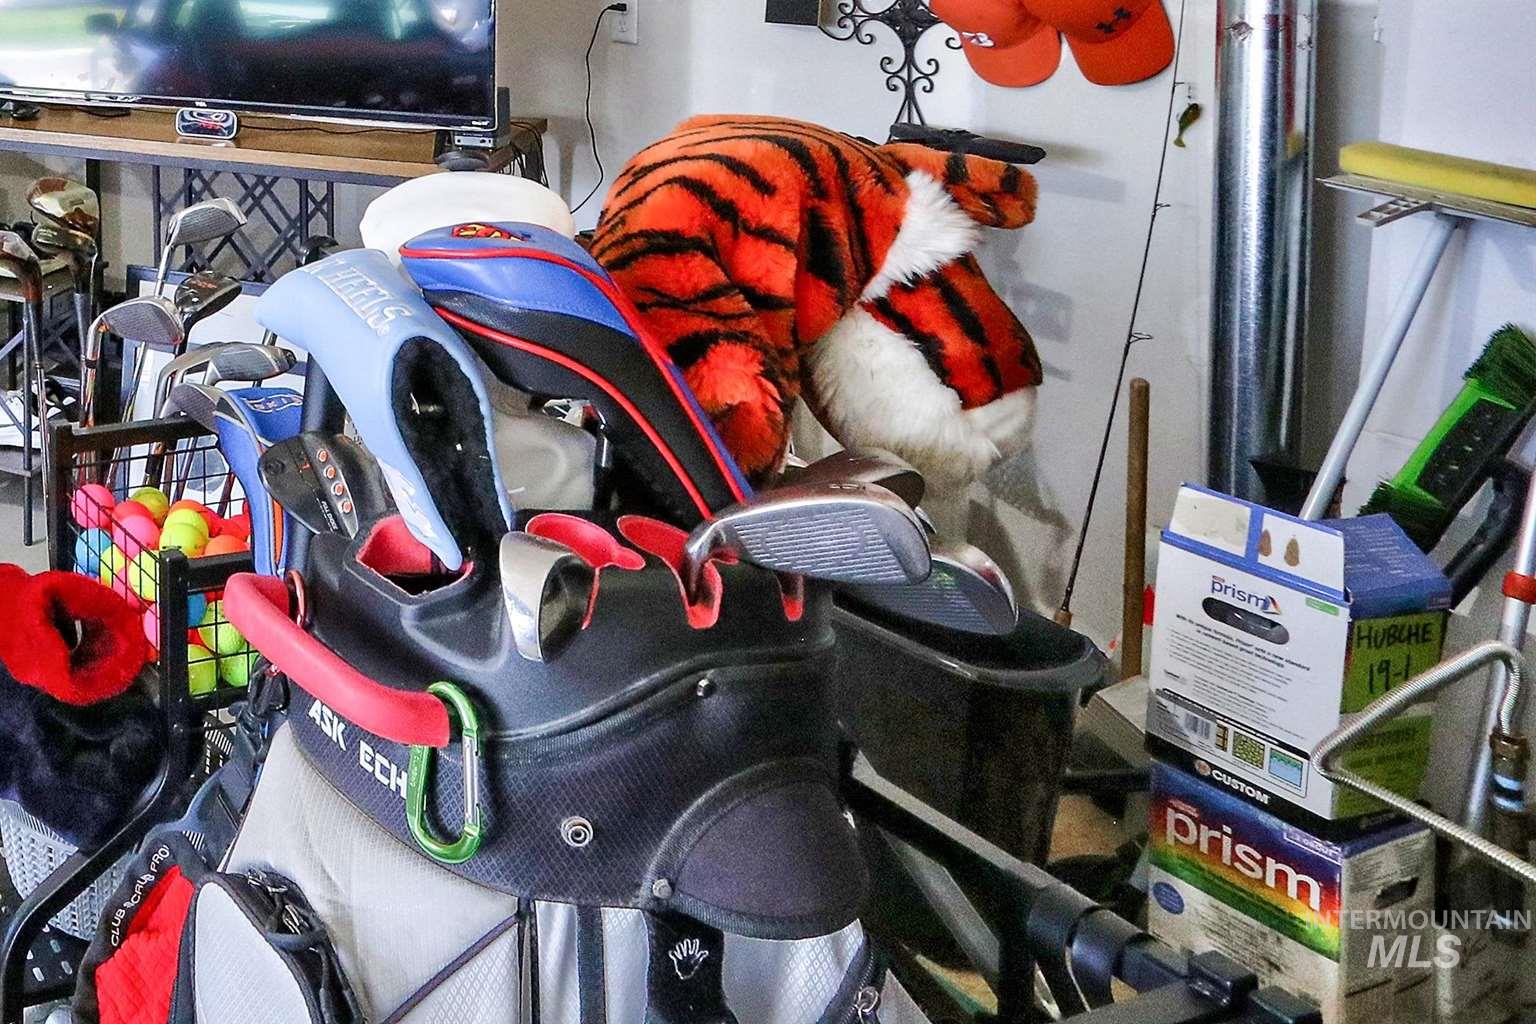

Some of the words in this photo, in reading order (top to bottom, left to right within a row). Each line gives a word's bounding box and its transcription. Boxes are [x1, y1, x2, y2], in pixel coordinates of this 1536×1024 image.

[1211, 578, 1267, 608] prism
[308, 699, 347, 752] ASK
[1211, 770, 1272, 805] CUSTOM
[1166, 807, 1322, 912] prism
[110, 907, 127, 948] CLUB
